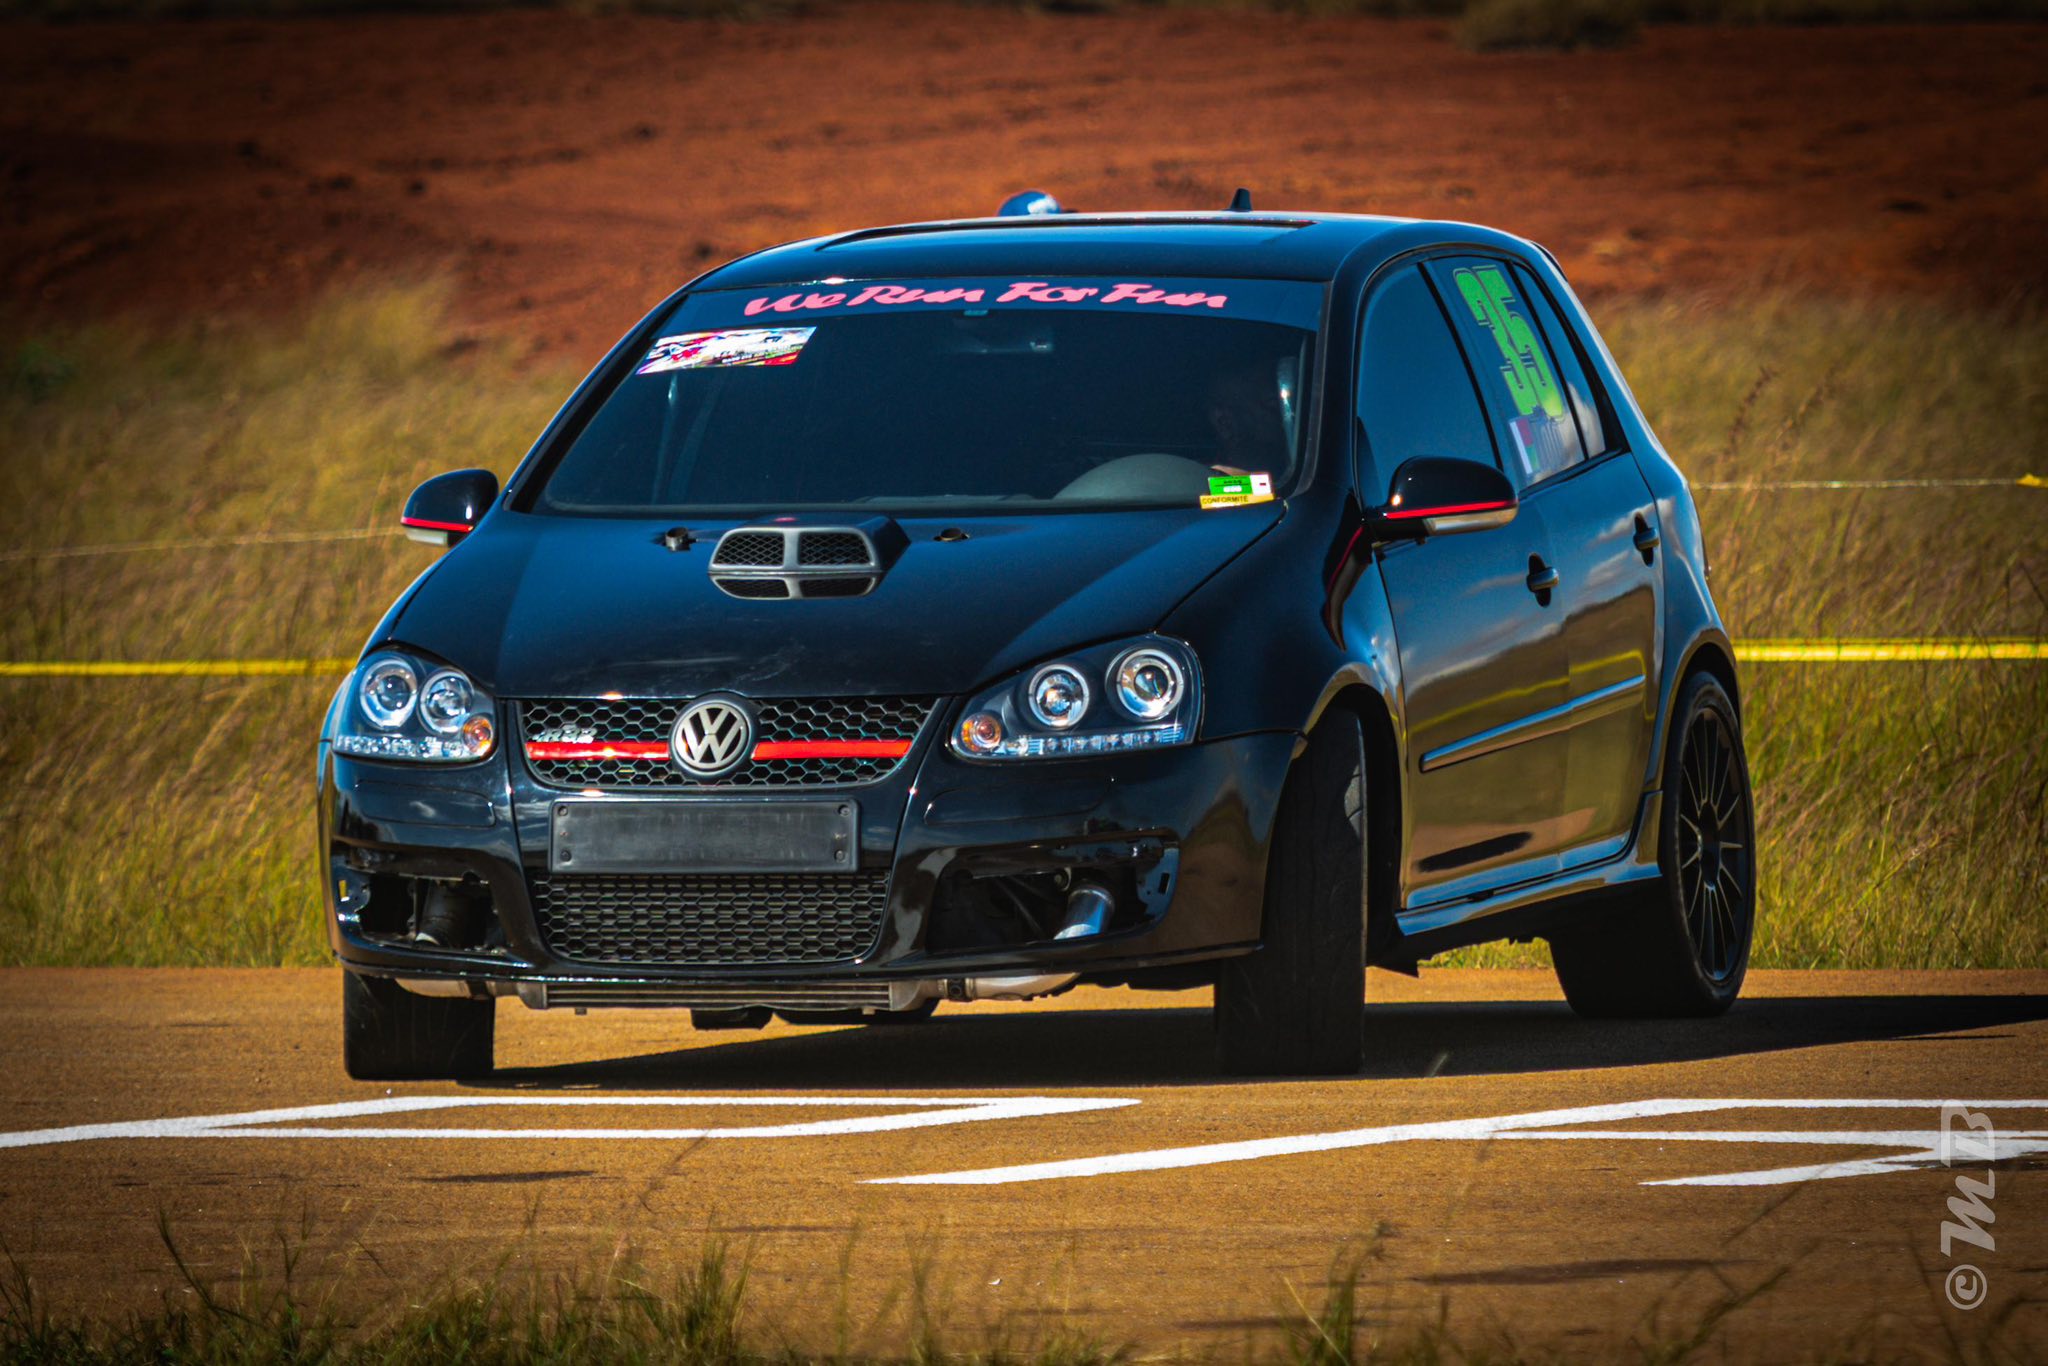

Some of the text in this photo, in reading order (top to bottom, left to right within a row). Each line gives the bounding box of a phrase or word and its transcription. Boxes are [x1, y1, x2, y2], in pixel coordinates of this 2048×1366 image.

[846, 285, 985, 306] Run
[996, 281, 1099, 303] For
[1100, 283, 1228, 309] Fun
[675, 701, 750, 769] VW
